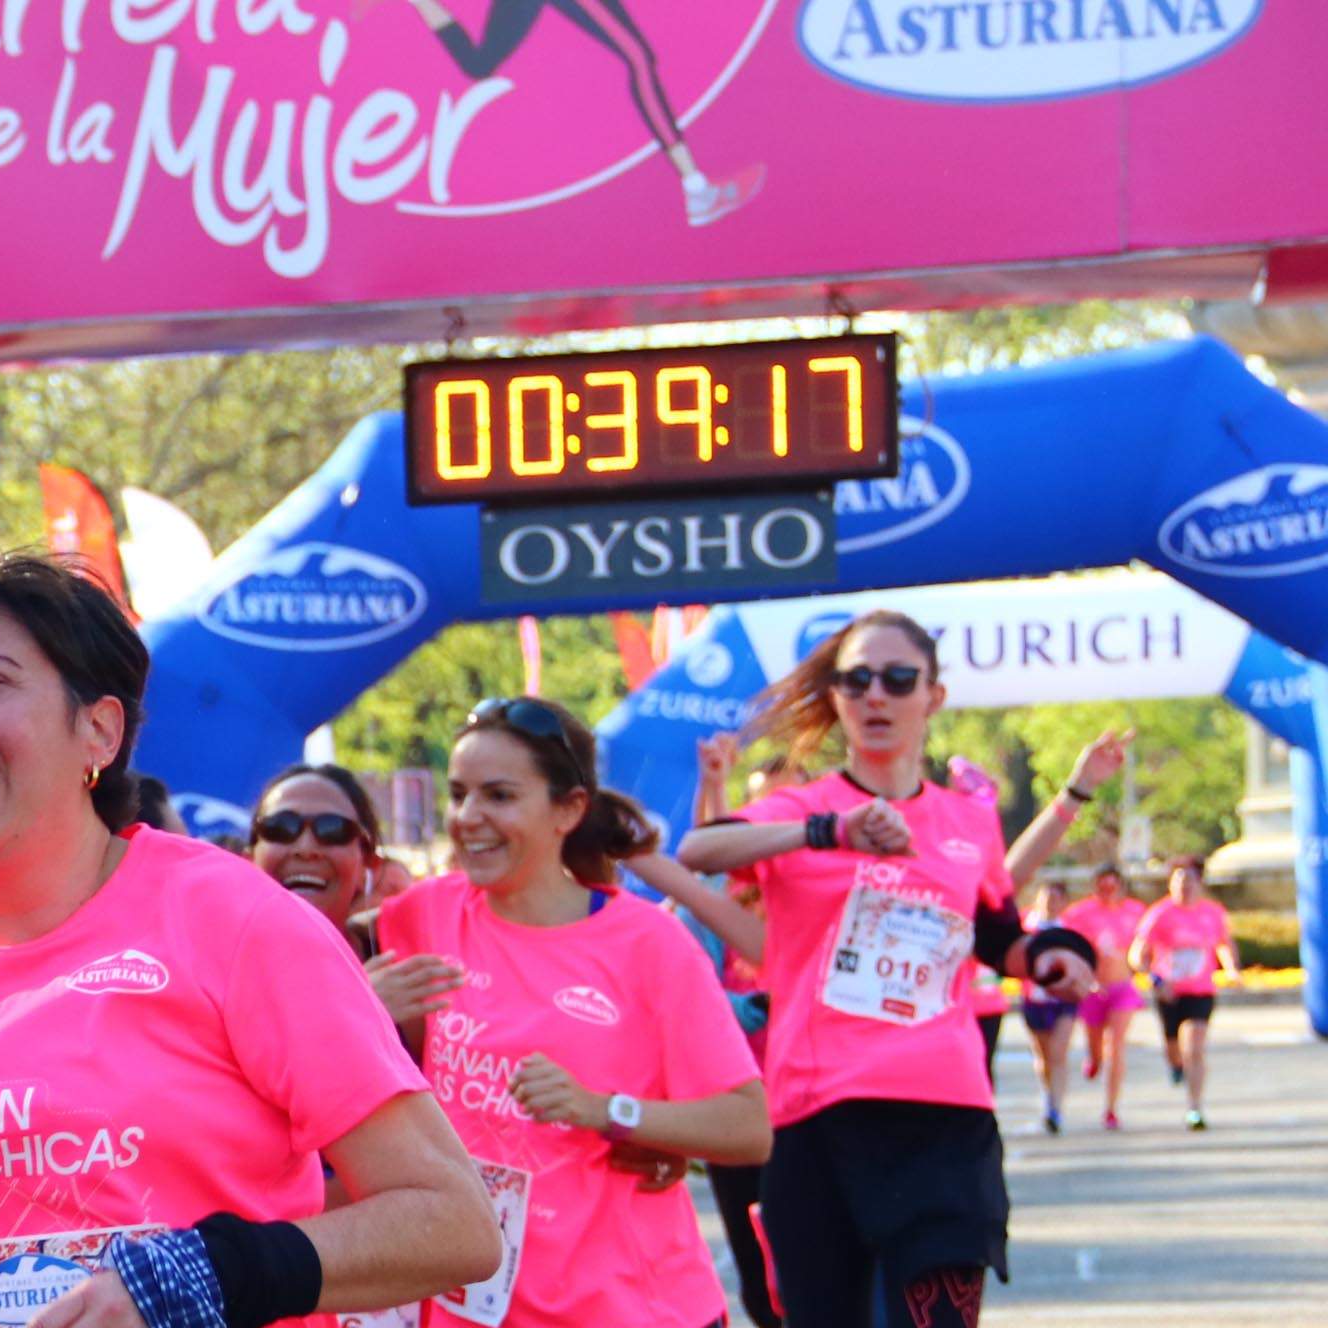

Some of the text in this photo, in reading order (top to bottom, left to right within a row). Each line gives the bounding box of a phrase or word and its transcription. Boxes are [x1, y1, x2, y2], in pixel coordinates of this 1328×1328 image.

[46, 57, 116, 166] la
[101, 19, 516, 279] Mujer
[434, 356, 864, 480] 00:39:17
[499, 507, 824, 585] OYSHO
[1182, 508, 1328, 560] ASTURI
[209, 582, 407, 624] ASTURIANA
[73, 966, 160, 987] ASTURIANA
[876, 956, 930, 987] 016
[436, 1010, 488, 1045] HOY
[431, 1036, 525, 1084] GANAN
